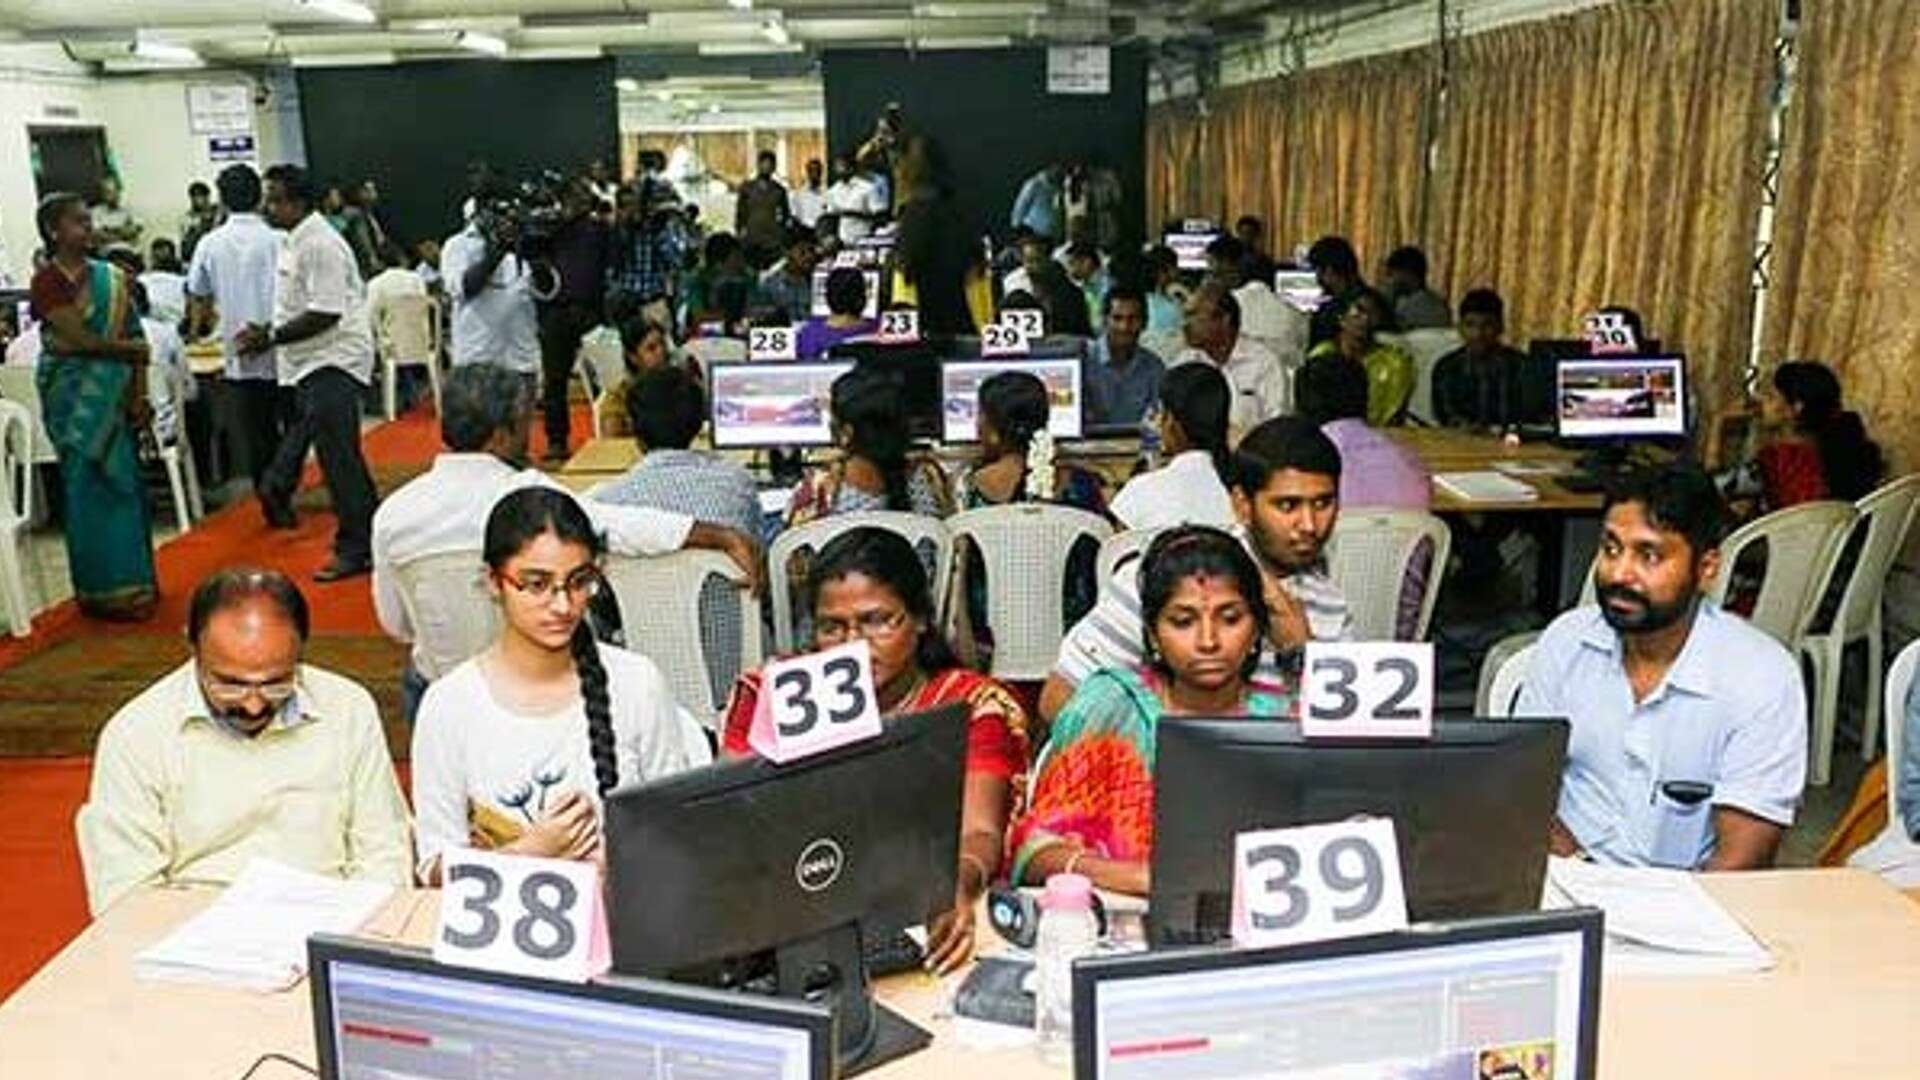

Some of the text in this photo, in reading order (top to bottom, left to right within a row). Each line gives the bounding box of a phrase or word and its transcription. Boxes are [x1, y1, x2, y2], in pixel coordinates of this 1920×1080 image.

[753, 331, 788, 353] 28
[884, 314, 912, 335] 23
[985, 328, 1019, 347] 29
[775, 657, 867, 737] 33
[1309, 657, 1422, 720] 32
[442, 863, 579, 961] 38
[1246, 836, 1386, 931] 39
